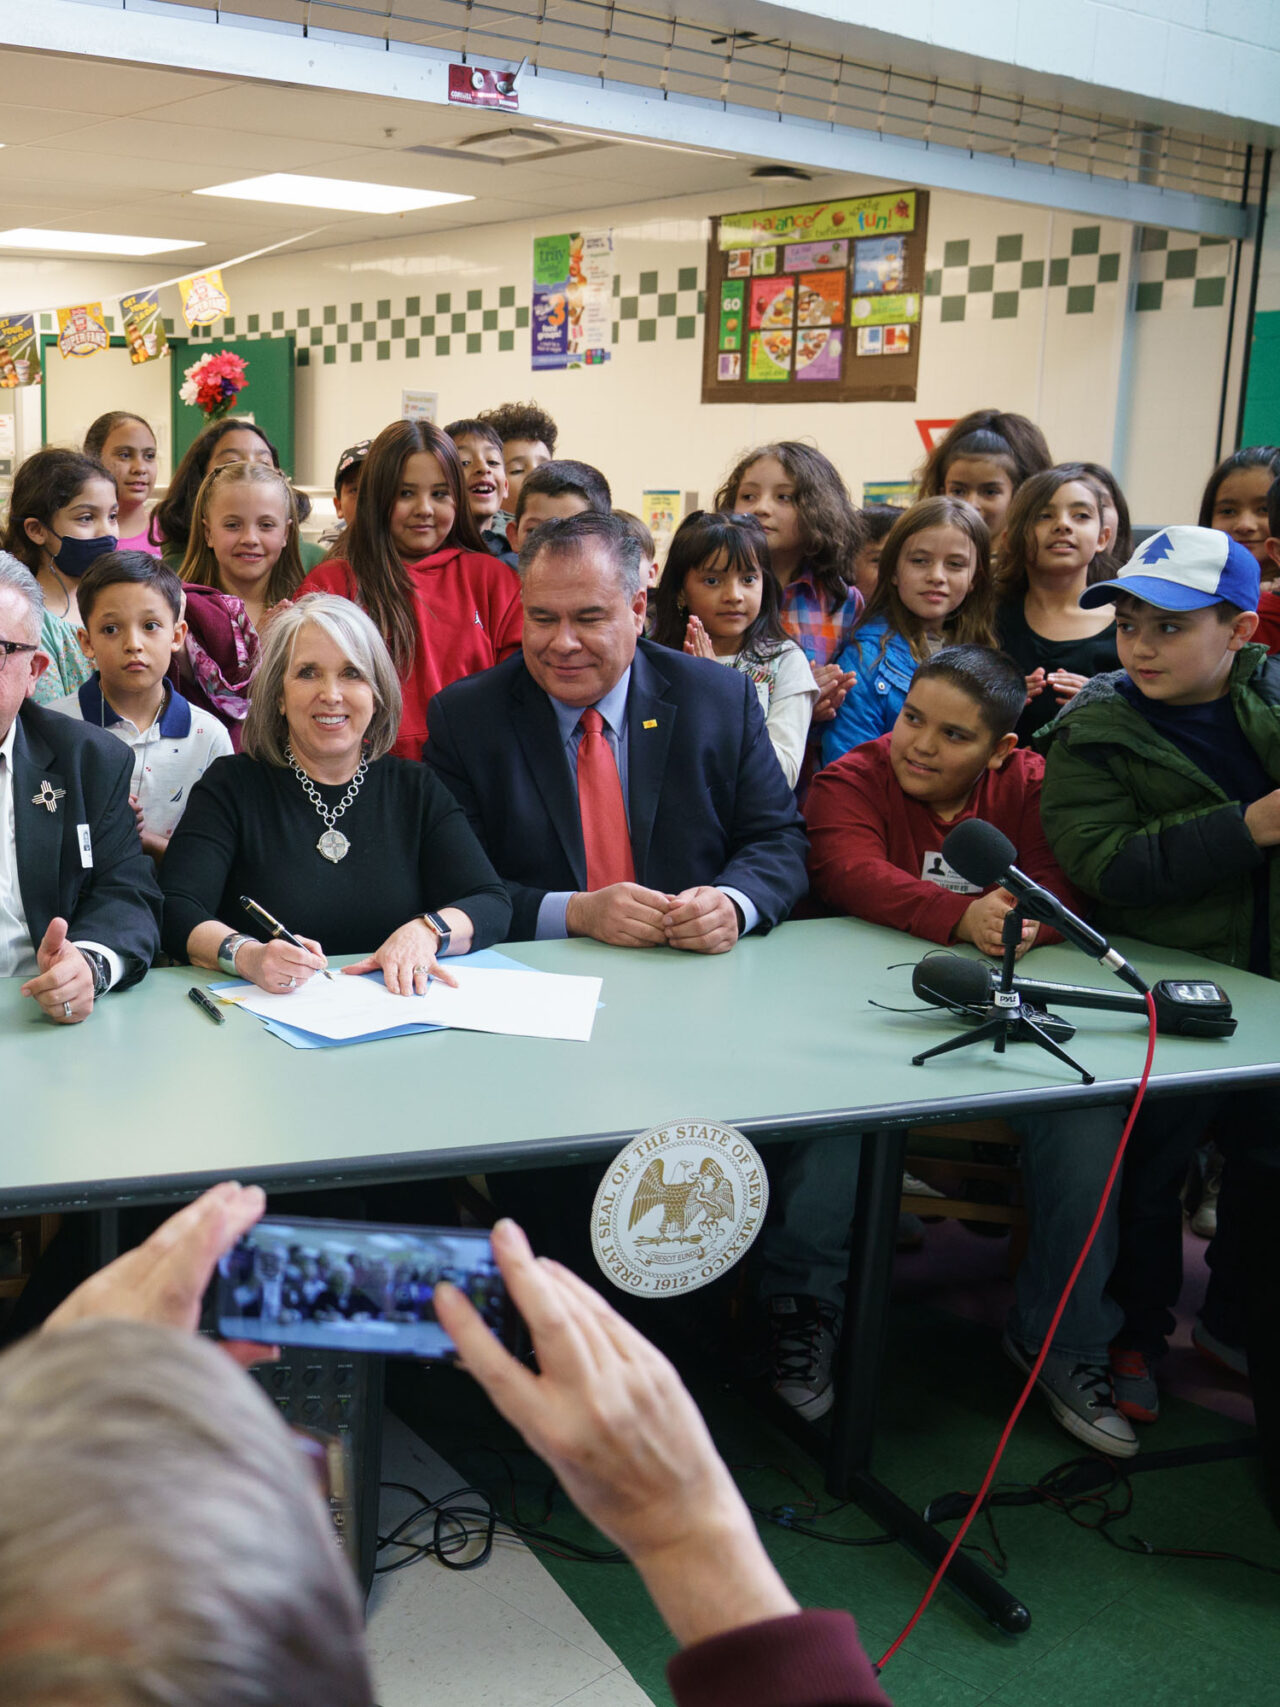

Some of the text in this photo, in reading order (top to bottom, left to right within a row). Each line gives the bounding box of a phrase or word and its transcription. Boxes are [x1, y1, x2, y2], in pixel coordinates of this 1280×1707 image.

[752, 213, 814, 232] balance
[857, 209, 893, 231] fun!
[722, 298, 742, 312] 60
[2, 325, 24, 336] YOUR
[598, 1125, 762, 1287] GREAT SEAL OF THE STATE OF NEW MEXICO
[653, 1275, 689, 1291] 1912
